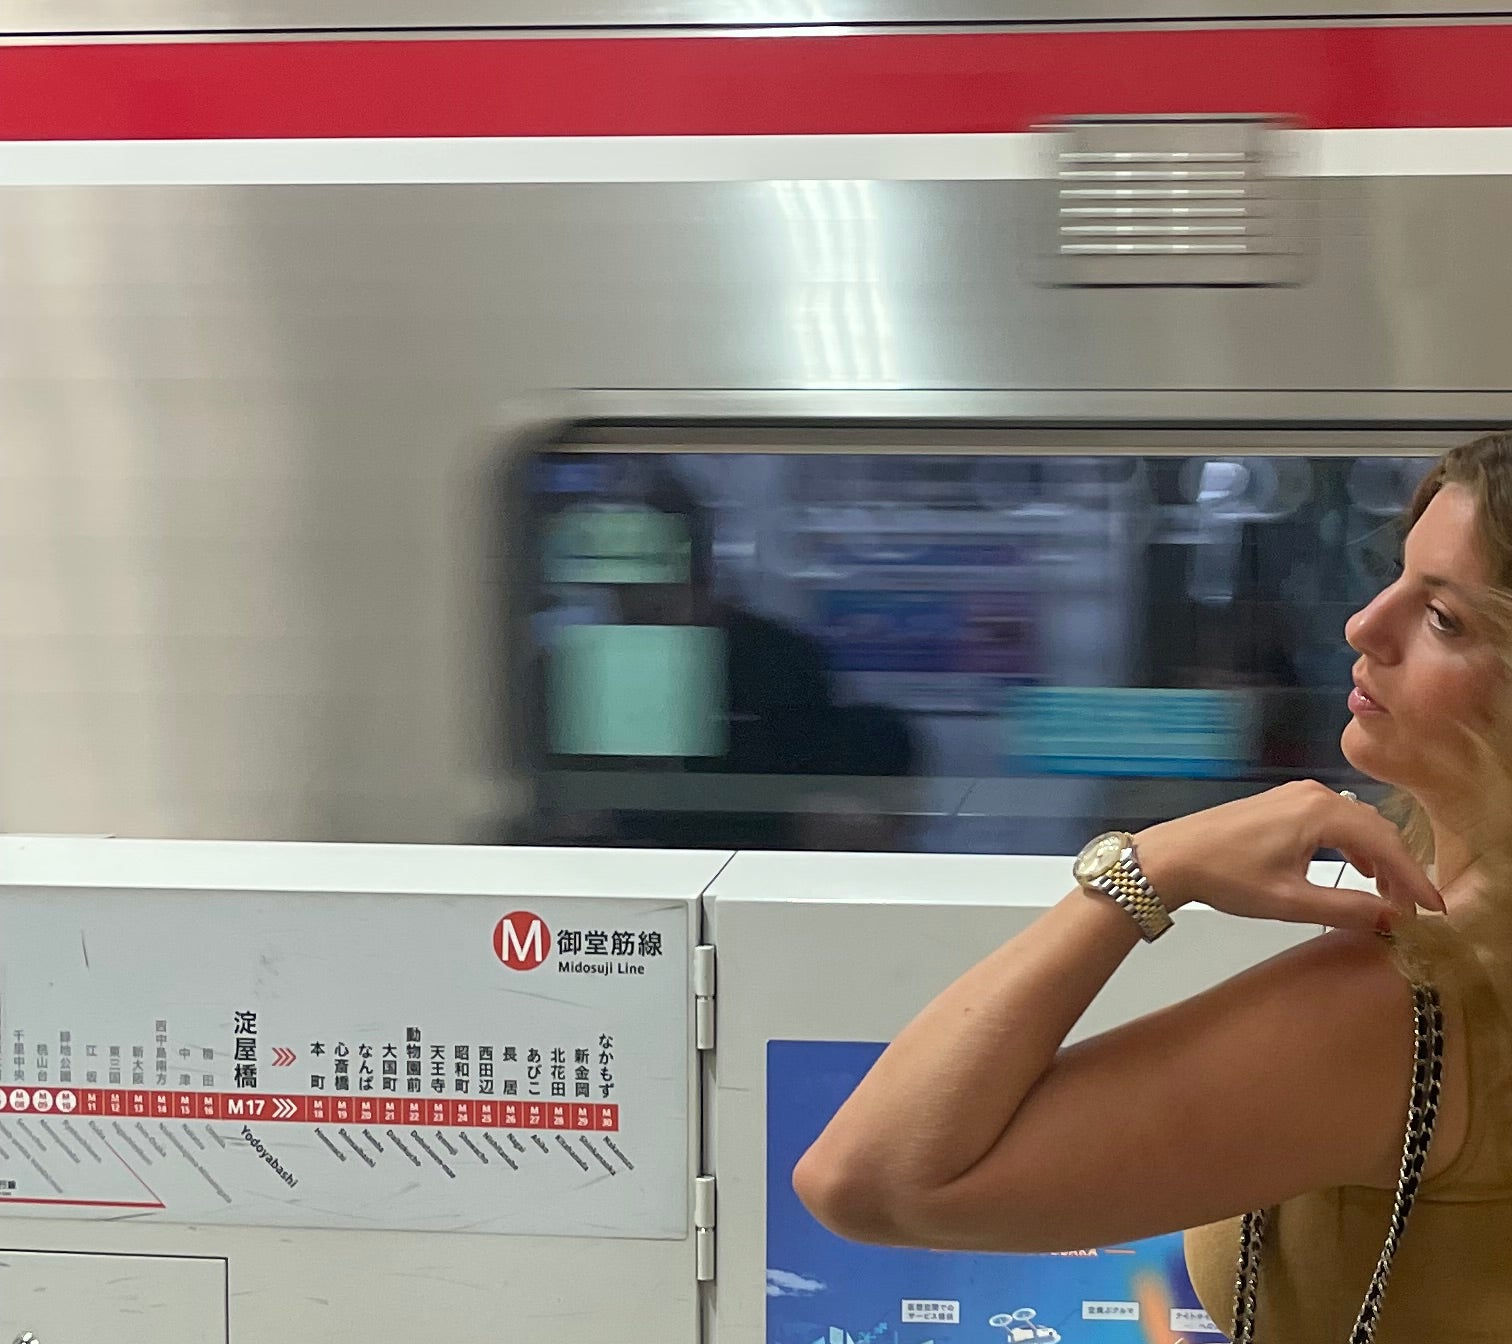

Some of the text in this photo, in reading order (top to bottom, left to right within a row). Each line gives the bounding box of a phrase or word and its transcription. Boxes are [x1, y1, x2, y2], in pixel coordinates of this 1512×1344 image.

[502, 919, 543, 962] M
[557, 929, 663, 956] 御堂筋線
[558, 961, 645, 976] Midosuji Line
[234, 1010, 258, 1089] 淀屋橋
[310, 1041, 325, 1090] 本町
[334, 1042, 349, 1091] 心斎橋
[358, 1043, 374, 1091] なんば
[382, 1043, 398, 1092] 大国町
[406, 1027, 421, 1094] 動物園前
[430, 1044, 446, 1094] 天王寺
[454, 1045, 470, 1094] 昭和町
[479, 1046, 494, 1095] 西田辺
[502, 1046, 518, 1096] 長居
[527, 1048, 542, 1096] あびこ
[551, 1048, 566, 1097] 北花田
[574, 1048, 590, 1098] 新金岡
[598, 1033, 614, 1099] なかもず
[228, 1099, 265, 1116] M17
[240, 1124, 298, 1188] Yodoyabashi
[362, 1129, 384, 1153] Namba
[507, 1133, 526, 1153] Nagai
[530, 1134, 550, 1154] Abiko
